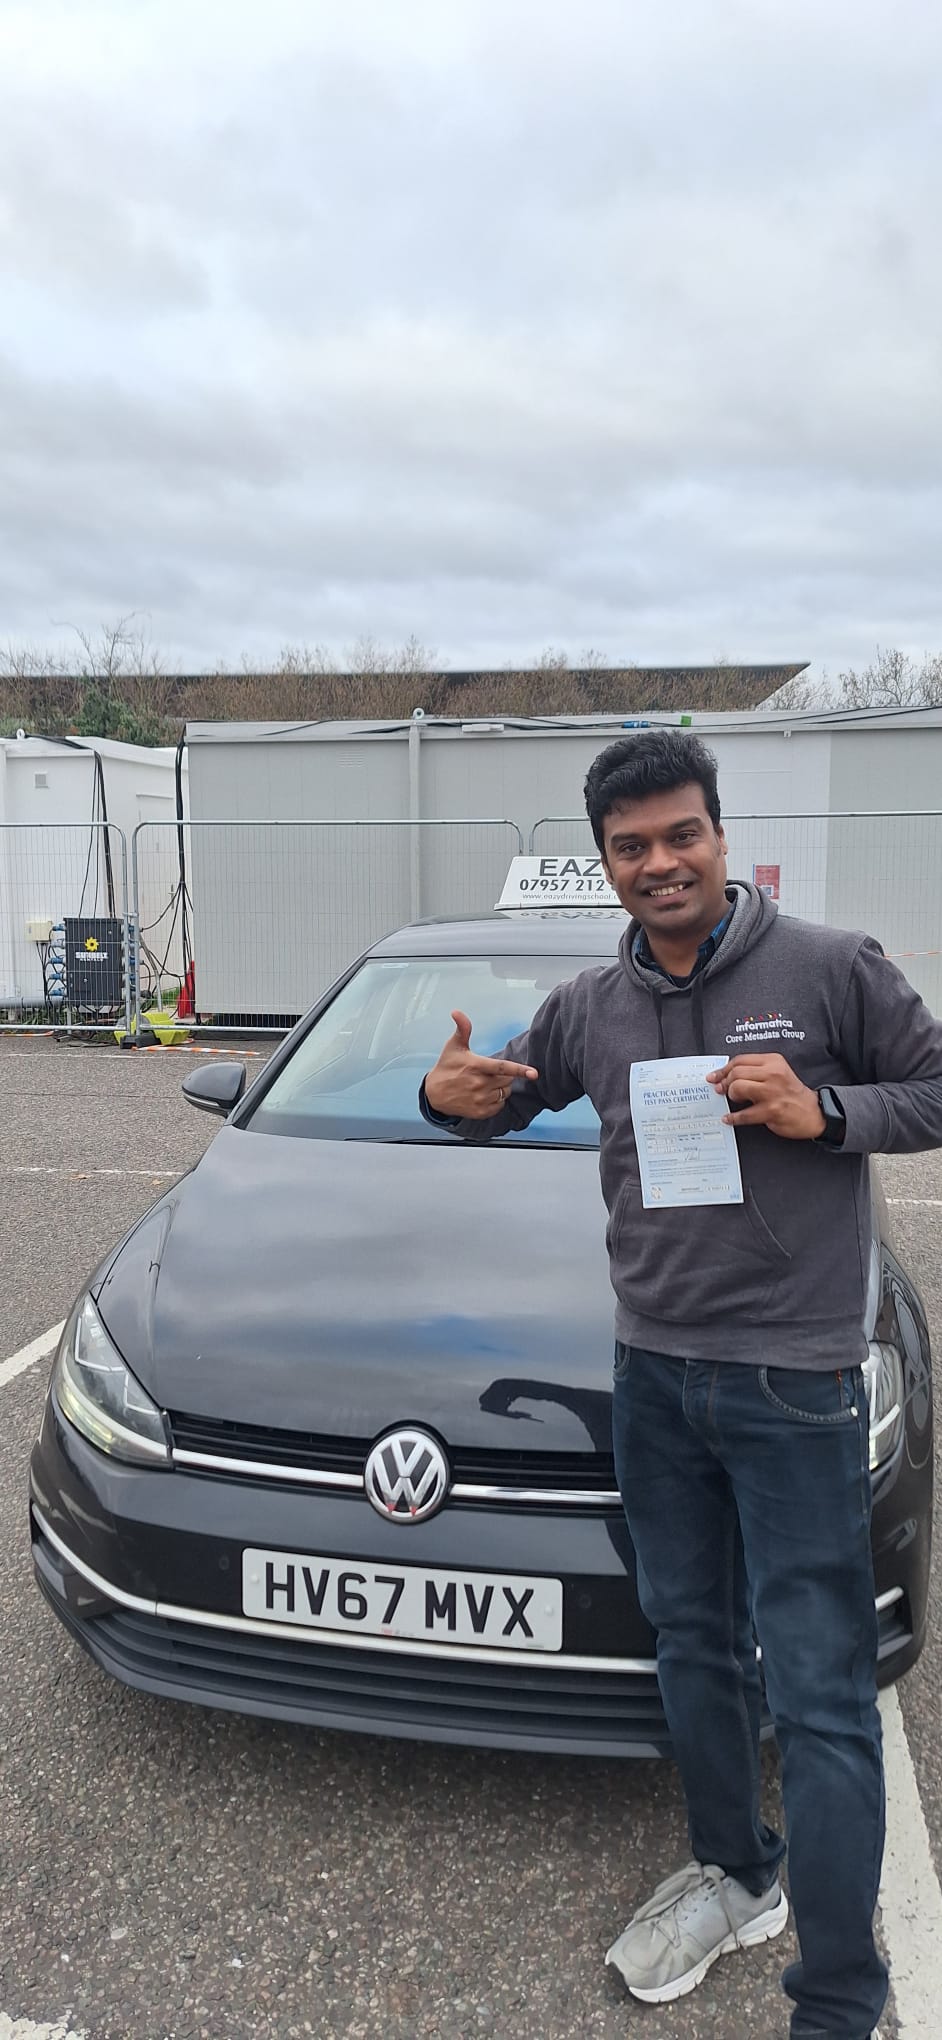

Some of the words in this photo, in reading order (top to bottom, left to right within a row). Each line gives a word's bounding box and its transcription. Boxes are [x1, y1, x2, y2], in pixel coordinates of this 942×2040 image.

[519, 879, 570, 891] 07957
[575, 879, 605, 891] 212
[735, 1013, 793, 1032] informatica
[725, 1034, 743, 1044] Core
[744, 1030, 780, 1042] Metadata
[781, 1028, 806, 1040] Group
[643, 1089, 678, 1098] PRACTICAL
[679, 1085, 710, 1095] DRIVING
[673, 1094, 710, 1103] CERTIFICATE
[265, 1561, 405, 1624] HV67
[425, 1580, 535, 1638] MVX
